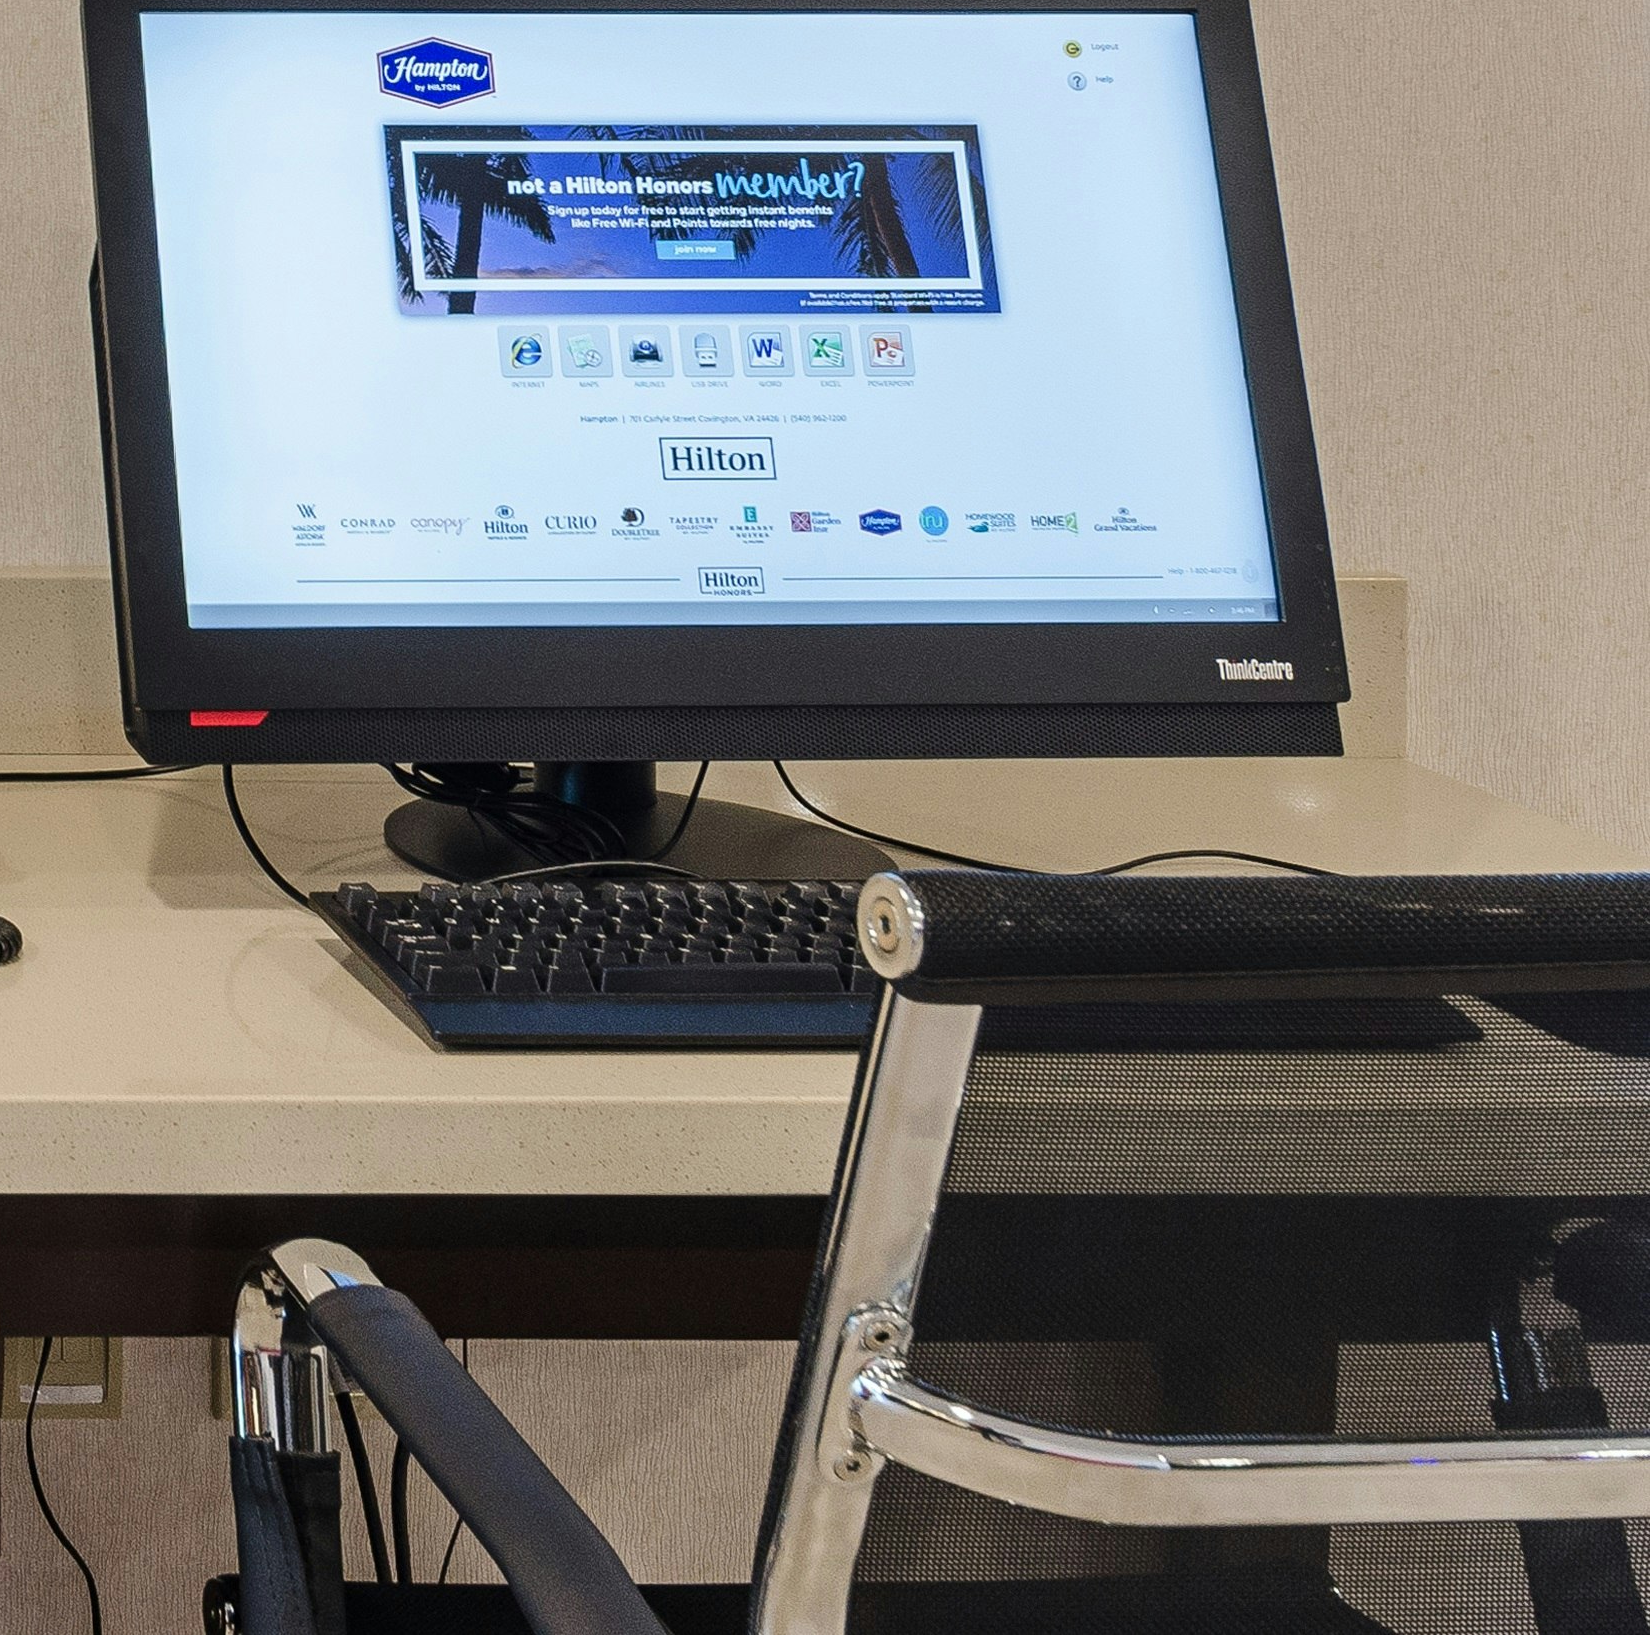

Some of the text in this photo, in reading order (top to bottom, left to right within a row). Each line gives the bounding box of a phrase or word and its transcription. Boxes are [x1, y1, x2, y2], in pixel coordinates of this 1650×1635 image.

[383, 55, 489, 84] Hampton
[414, 83, 462, 93] by HILTON
[507, 158, 865, 200] not a Hilton Honors member?
[547, 204, 834, 217] Sign up today for free to start getting instant benefits
[571, 218, 816, 230] like Free Wi-Fi and Points towards free nights.
[673, 244, 717, 255] join now
[579, 415, 618, 424] Hampton
[672, 415, 697, 423] Street
[670, 446, 767, 472] Hilton
[340, 518, 396, 528] CONRAD
[409, 516, 471, 536] canopy
[483, 520, 529, 534] Hilton
[544, 515, 597, 530] CURIO
[704, 571, 759, 587] Hilton
[1215, 658, 1295, 681] ThinkCentre
